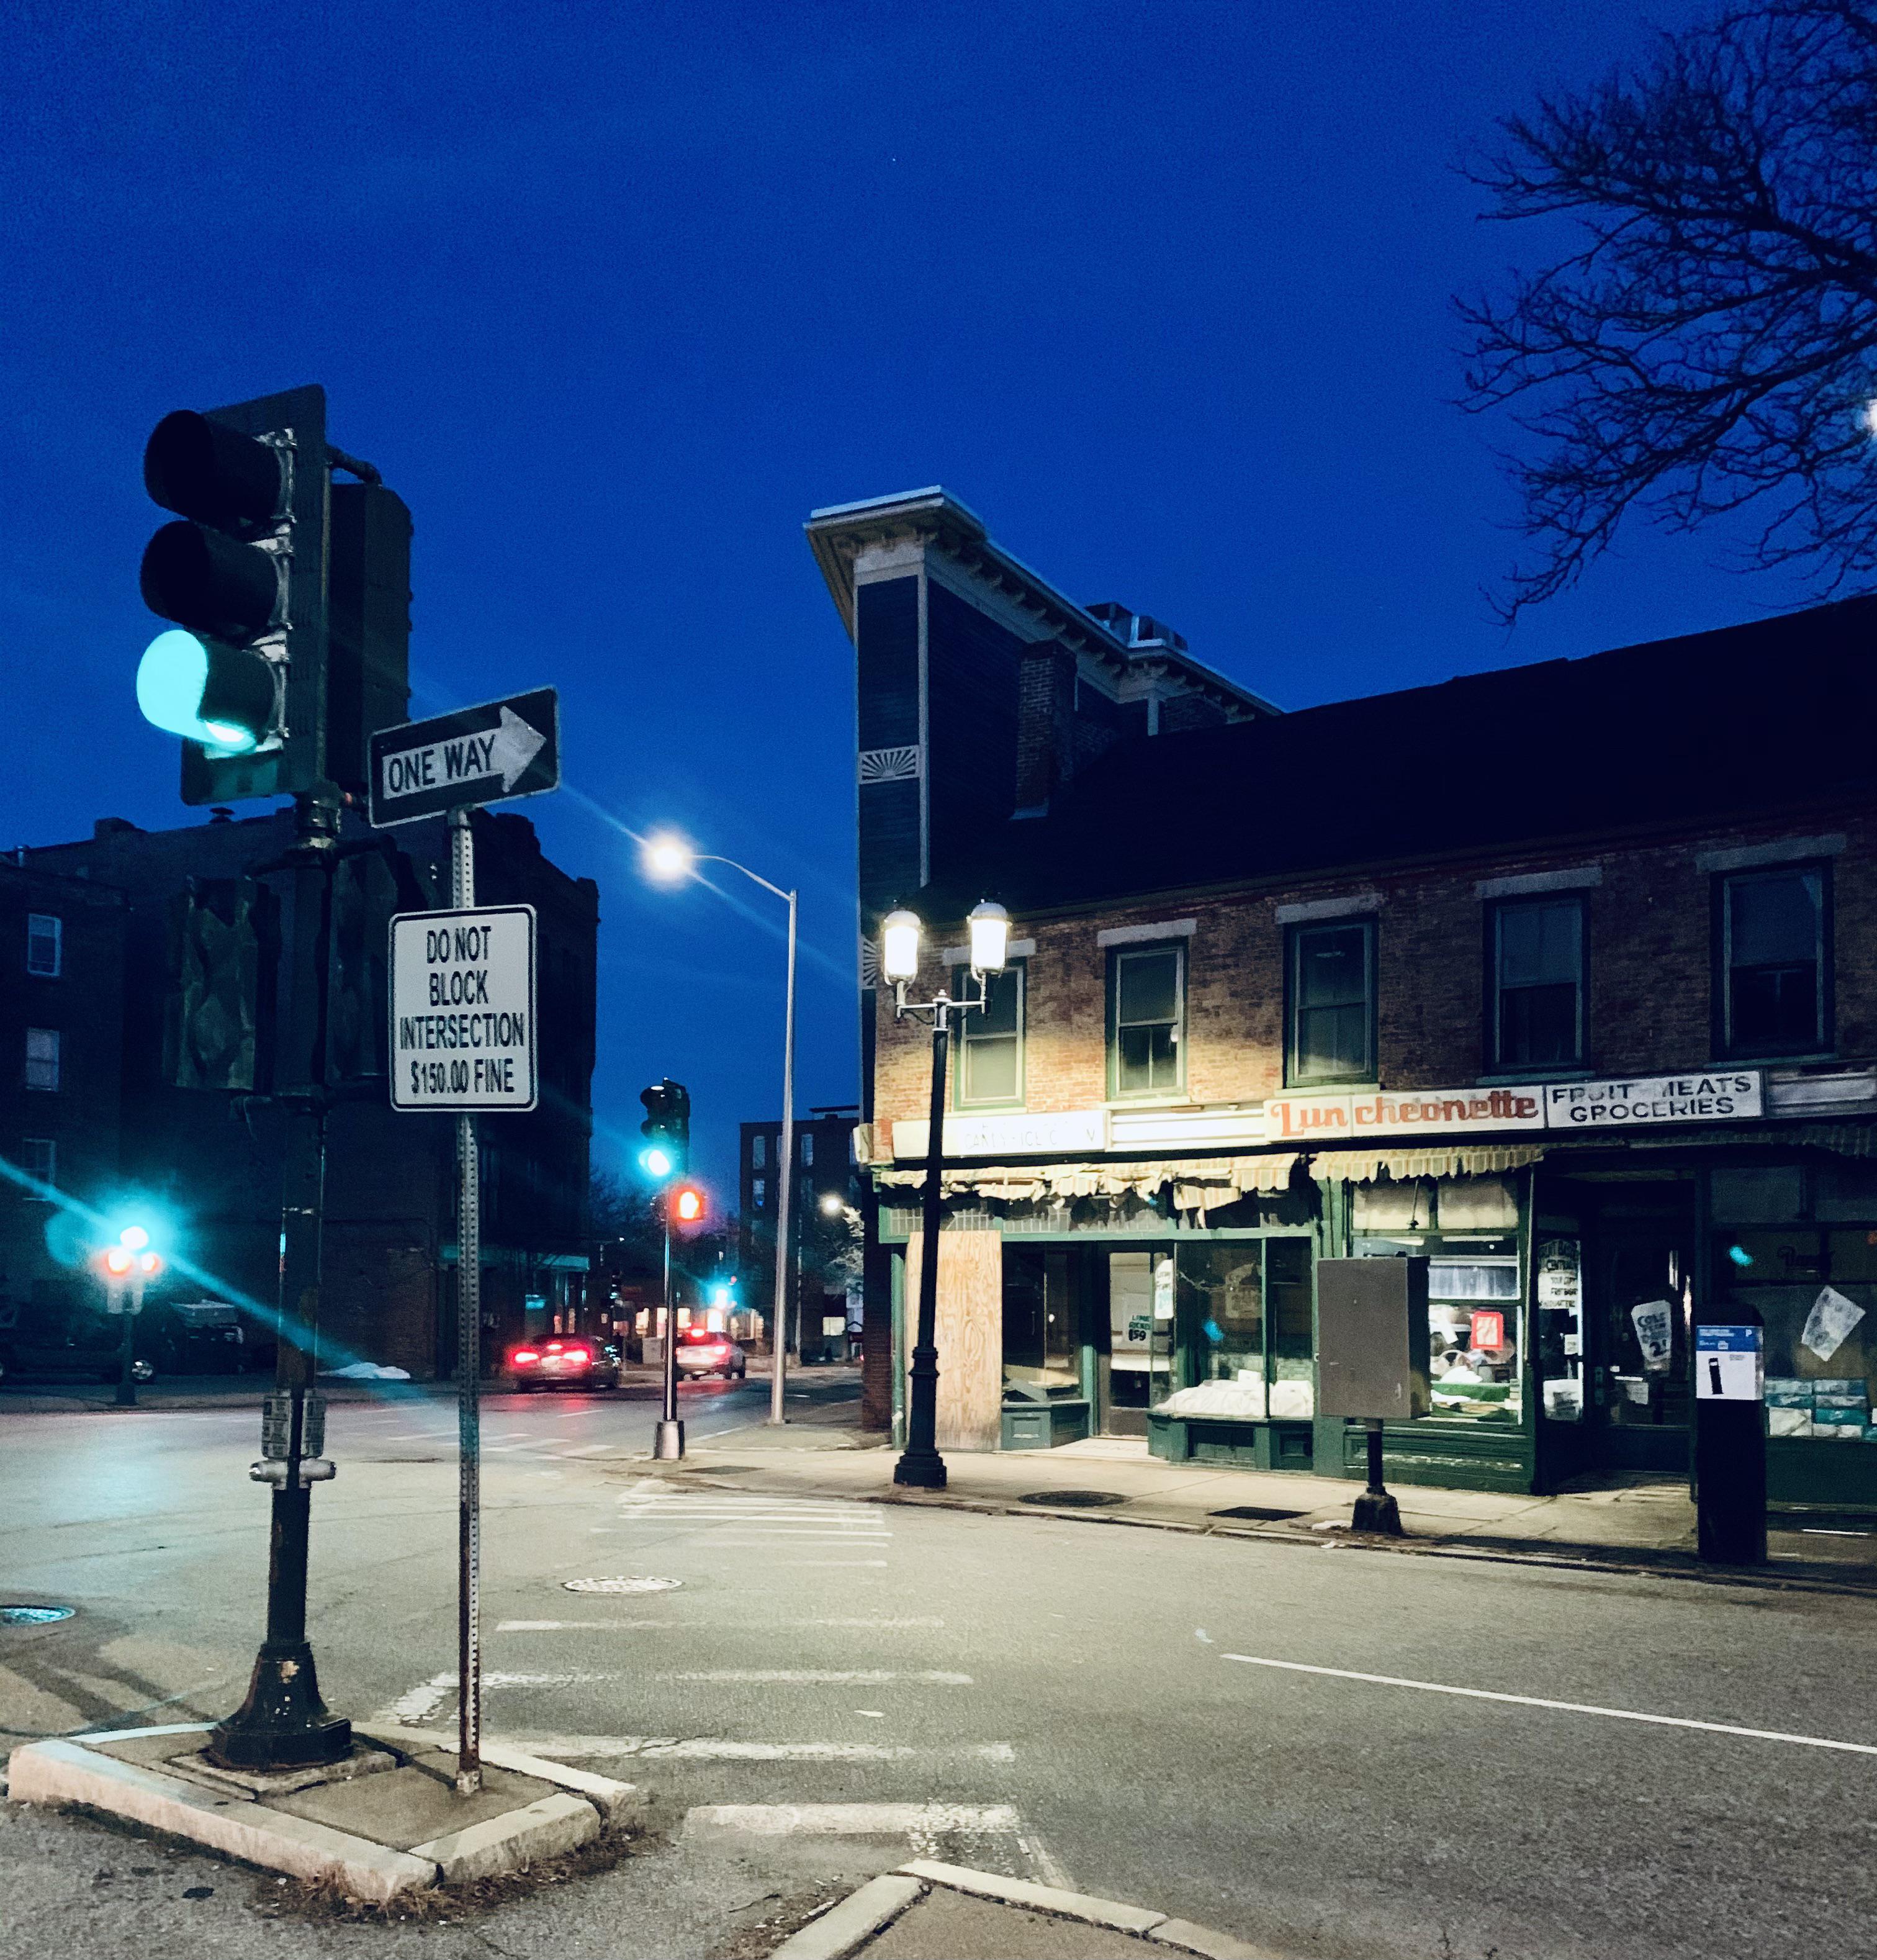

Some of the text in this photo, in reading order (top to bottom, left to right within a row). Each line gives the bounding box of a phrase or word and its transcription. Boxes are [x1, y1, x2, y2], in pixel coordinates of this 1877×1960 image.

[389, 734, 496, 792] ONE WAY
[426, 926, 492, 964] DO NOT
[429, 970, 489, 1006] BLOCK
[400, 1013, 524, 1049] INTERSECTION
[411, 1058, 515, 1095] $150.00 FINE
[1271, 1090, 1539, 1137] Luncheonette
[1570, 1096, 1734, 1122] GROCERIES
